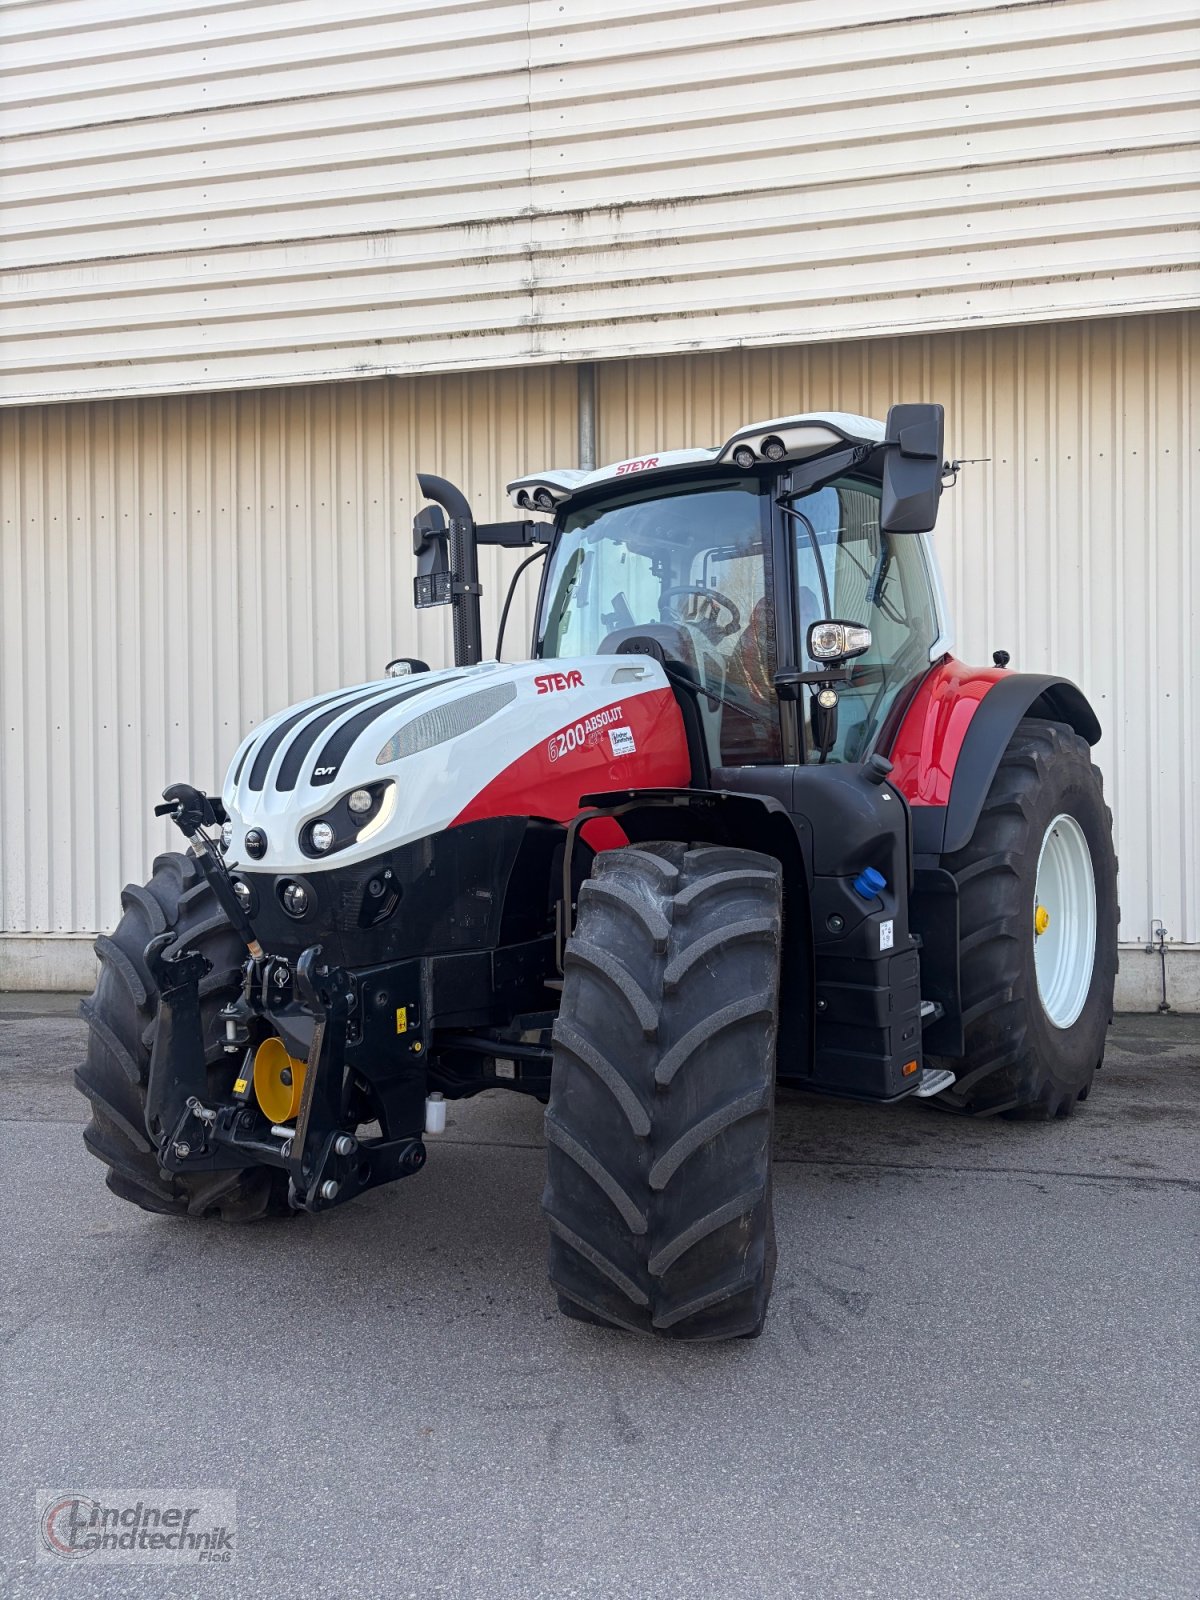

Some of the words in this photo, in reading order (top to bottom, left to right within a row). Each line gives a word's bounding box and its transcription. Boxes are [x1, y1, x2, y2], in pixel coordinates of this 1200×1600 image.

[615, 457, 659, 476] STEYR
[534, 670, 585, 695] STEYR
[548, 723, 586, 763] 6200
[585, 706, 624, 734] ABSOLUT
[314, 766, 336, 776] CVT
